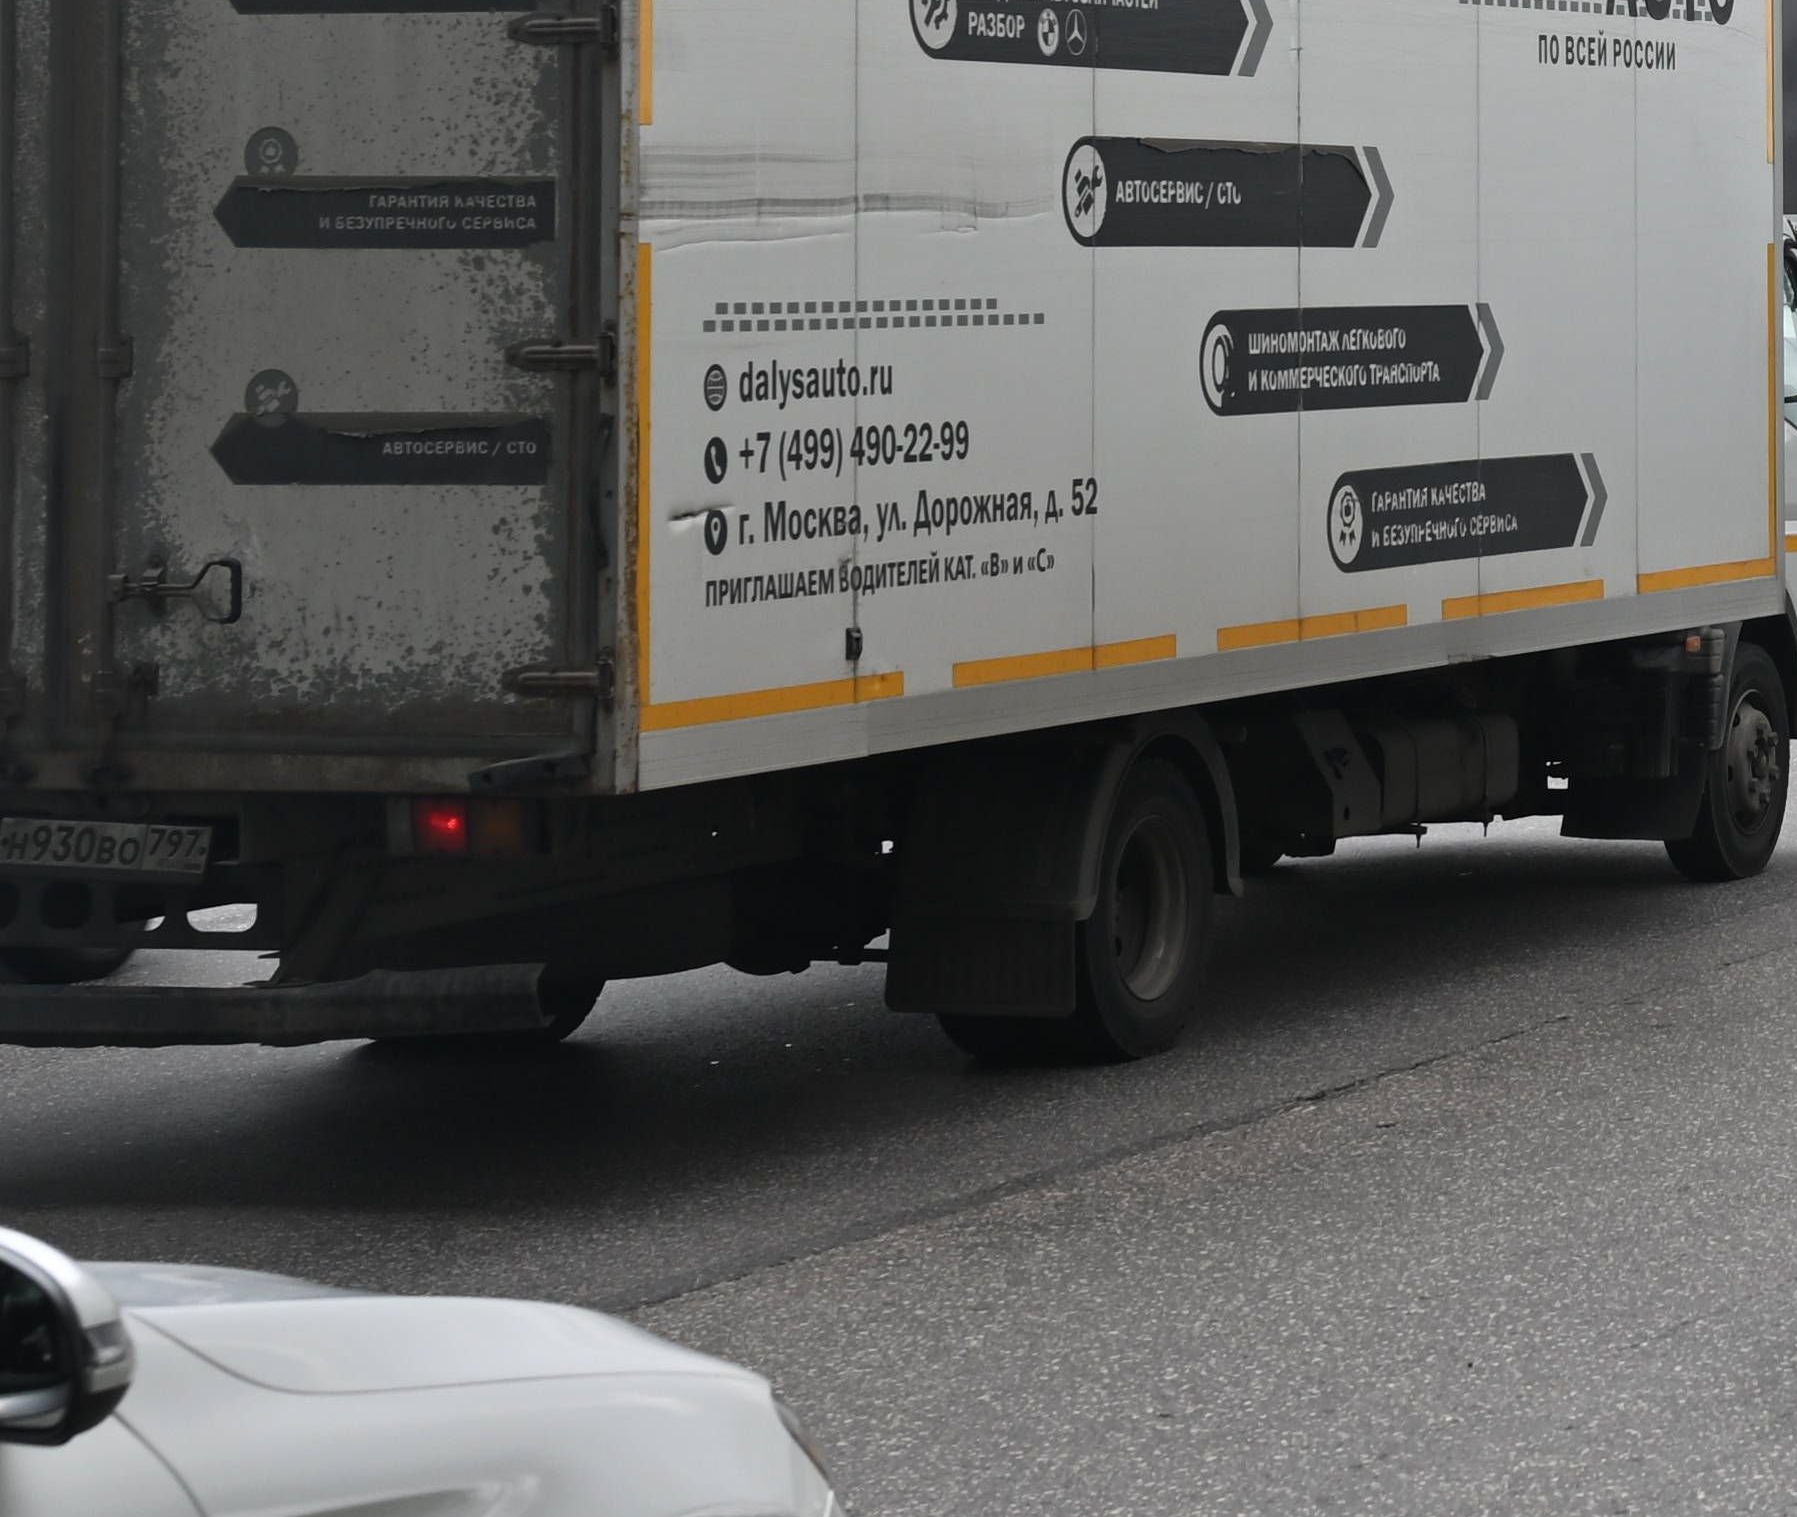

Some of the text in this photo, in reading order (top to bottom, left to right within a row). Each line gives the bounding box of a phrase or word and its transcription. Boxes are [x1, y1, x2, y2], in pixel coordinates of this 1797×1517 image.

[968, 11, 1026, 39] РАЗБОР
[1537, 30, 1677, 70] ПО ВСЕЙ РОССИИ
[369, 194, 537, 209] ГАРАНТИЯ КАЧЕСТВА
[1115, 179, 1203, 204] АВТОСЕРВИС
[318, 217, 330, 229] И
[461, 216, 537, 230] СЕРВИСА
[1248, 327, 1407, 354] ШИНОМОНТАЖ ЛЕГКОВОГО
[739, 358, 893, 410] dalysauto.ru
[1248, 360, 1441, 392] И КОММЕРЧЕСКОГО ТРАНСПОРТА
[381, 441, 489, 455] АВТОСЕРВИС
[506, 441, 537, 455] СТО
[738, 420, 969, 482] +7 (499) 490-22-99
[738, 477, 1099, 546] г. Москва, ул. Дорожная, д. 52
[1371, 481, 1487, 513] ГАРАНТИЯ КАЧЕСТВА
[705, 567, 835, 608] ПРИГЛАШАЕМ
[839, 550, 941, 597] ВОДИТЕЛЕЙ
[944, 554, 977, 583] КАТ.
[149, 829, 201, 858] 797
